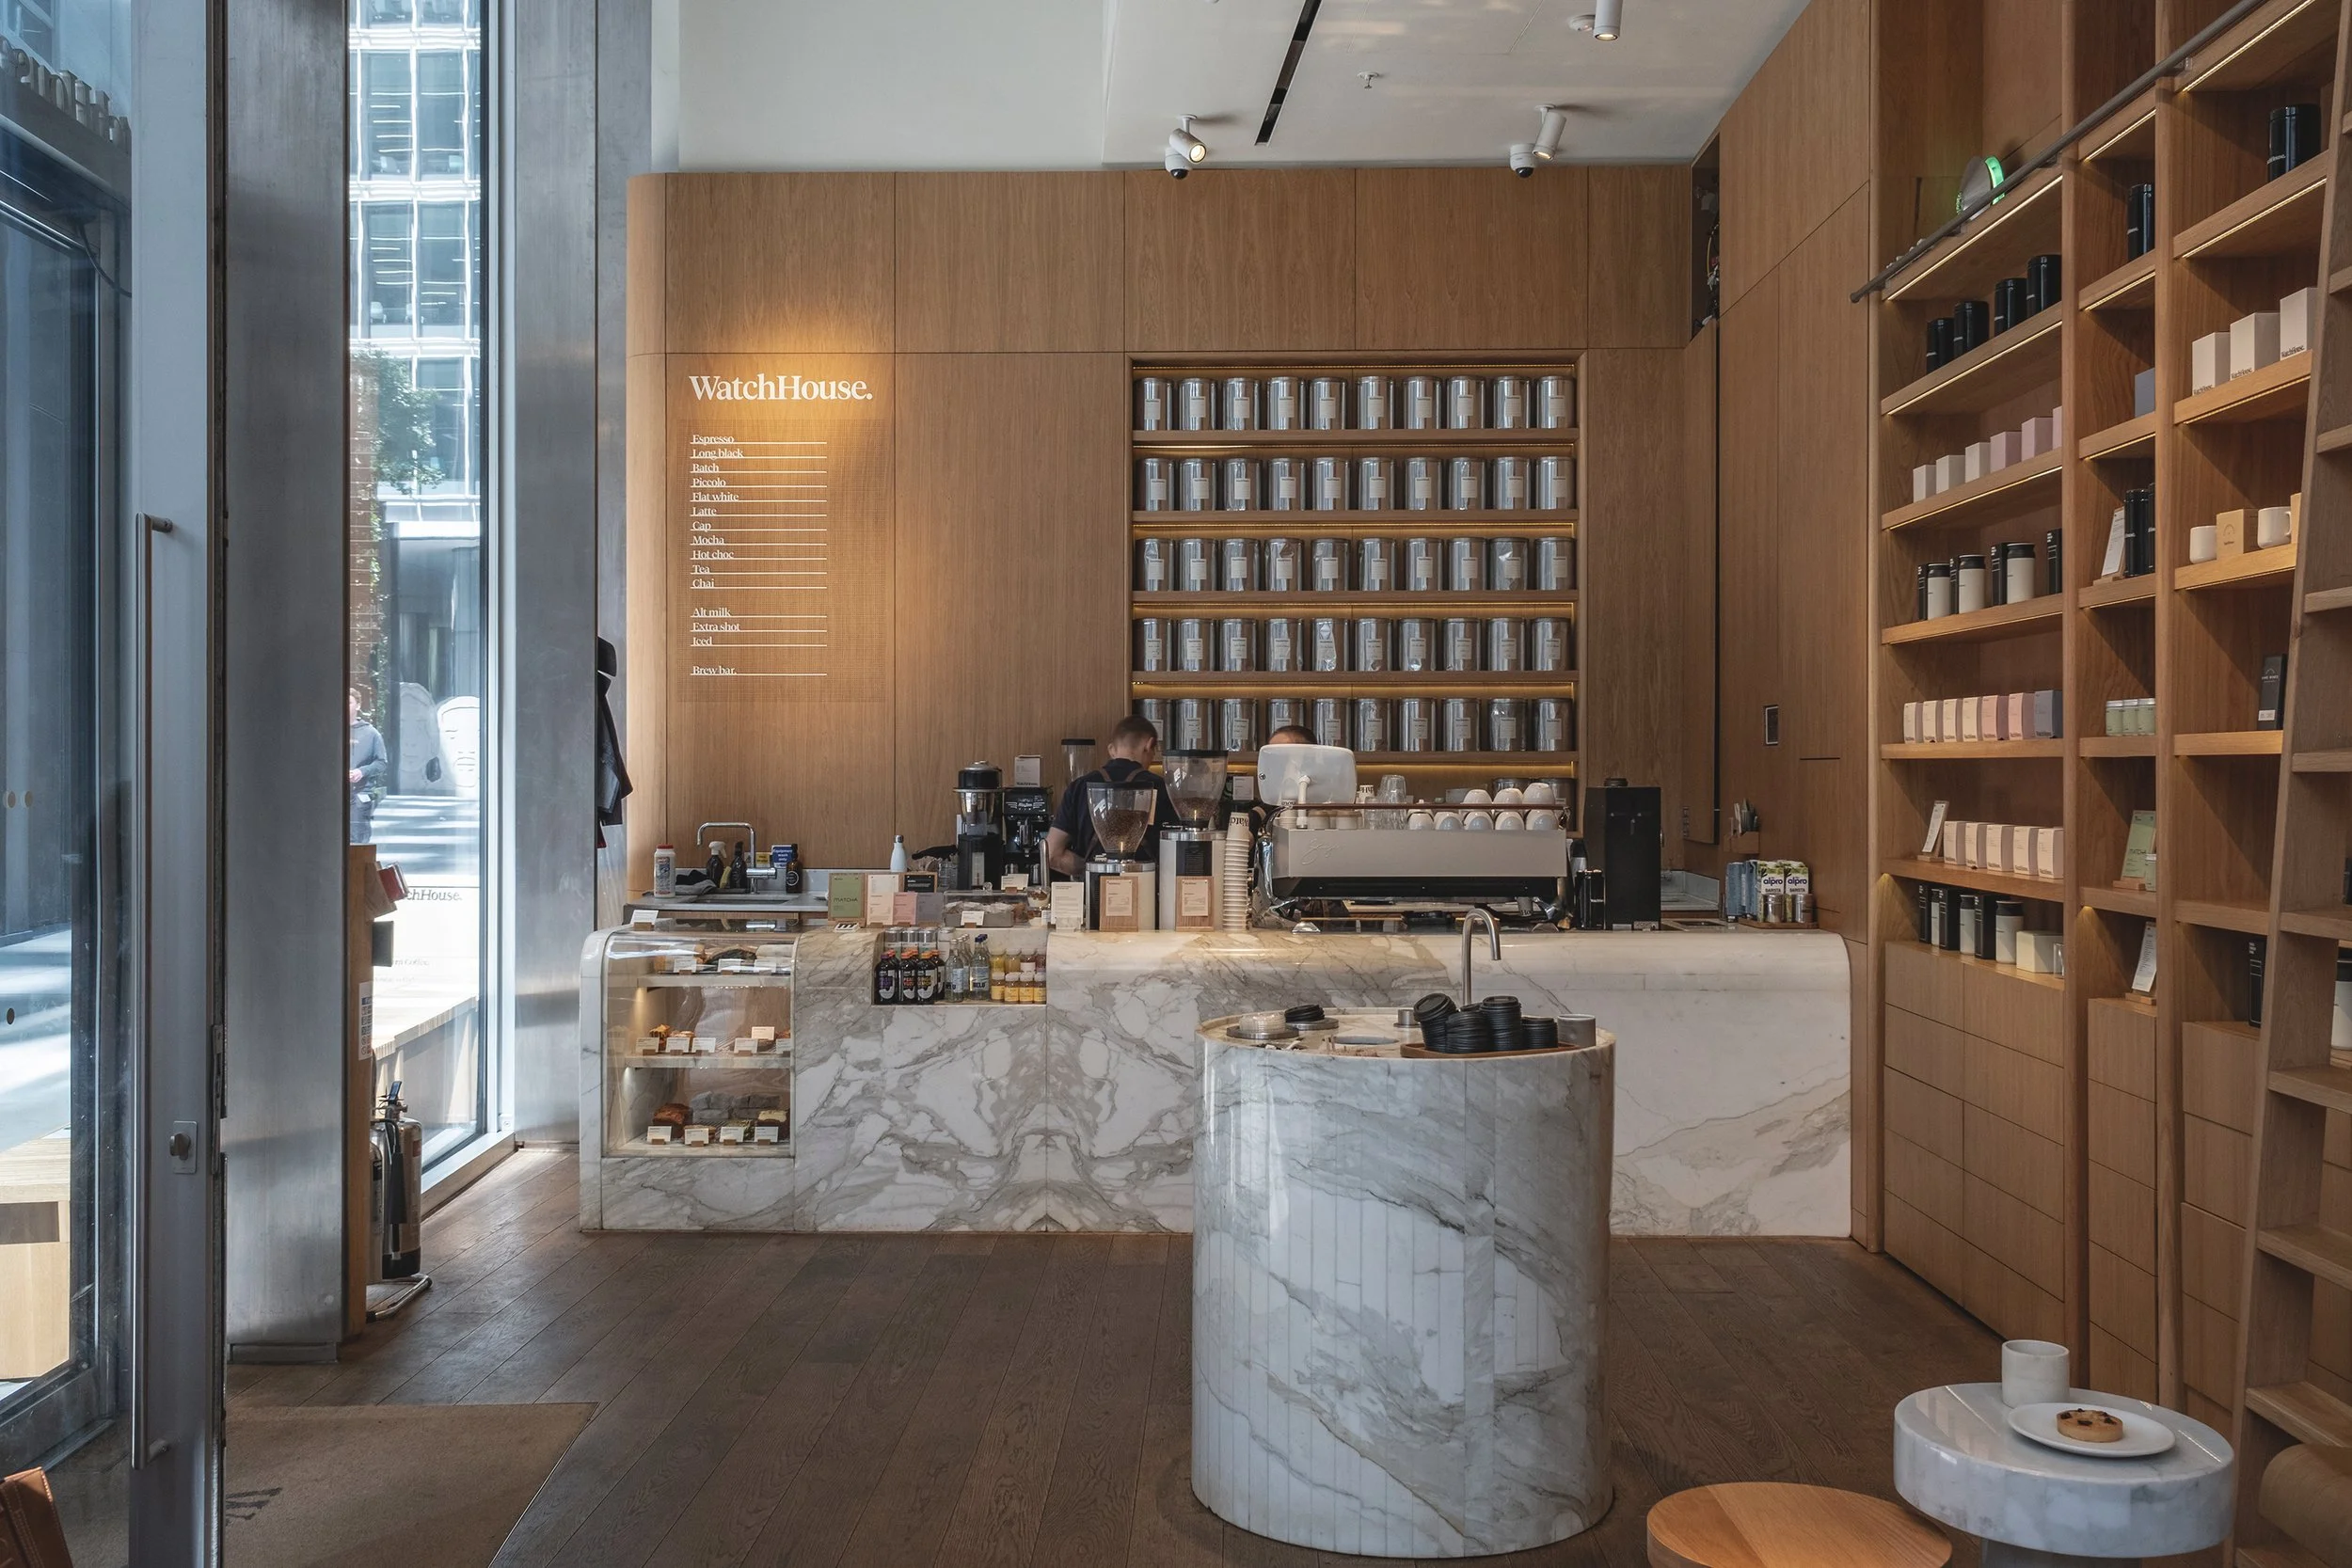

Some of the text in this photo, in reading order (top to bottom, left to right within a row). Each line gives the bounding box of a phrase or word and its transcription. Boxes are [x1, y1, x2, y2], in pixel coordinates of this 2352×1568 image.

[689, 373, 872, 401] WatchHouse.
[692, 435, 735, 445] Espresso
[692, 449, 743, 460] Long black
[692, 463, 720, 472] Batch
[692, 478, 726, 487] Piccolo
[692, 492, 739, 501] Flat white
[692, 506, 717, 516] Latte
[692, 521, 711, 532] Cap
[692, 535, 725, 545] Mocha
[692, 550, 735, 560] Hot choc
[692, 564, 710, 574] Tea
[692, 578, 715, 588] Chai
[692, 608, 731, 617] Alt milk
[692, 622, 740, 631] Extra shot
[692, 637, 712, 646] Iced
[692, 666, 738, 675] Brew bar.
